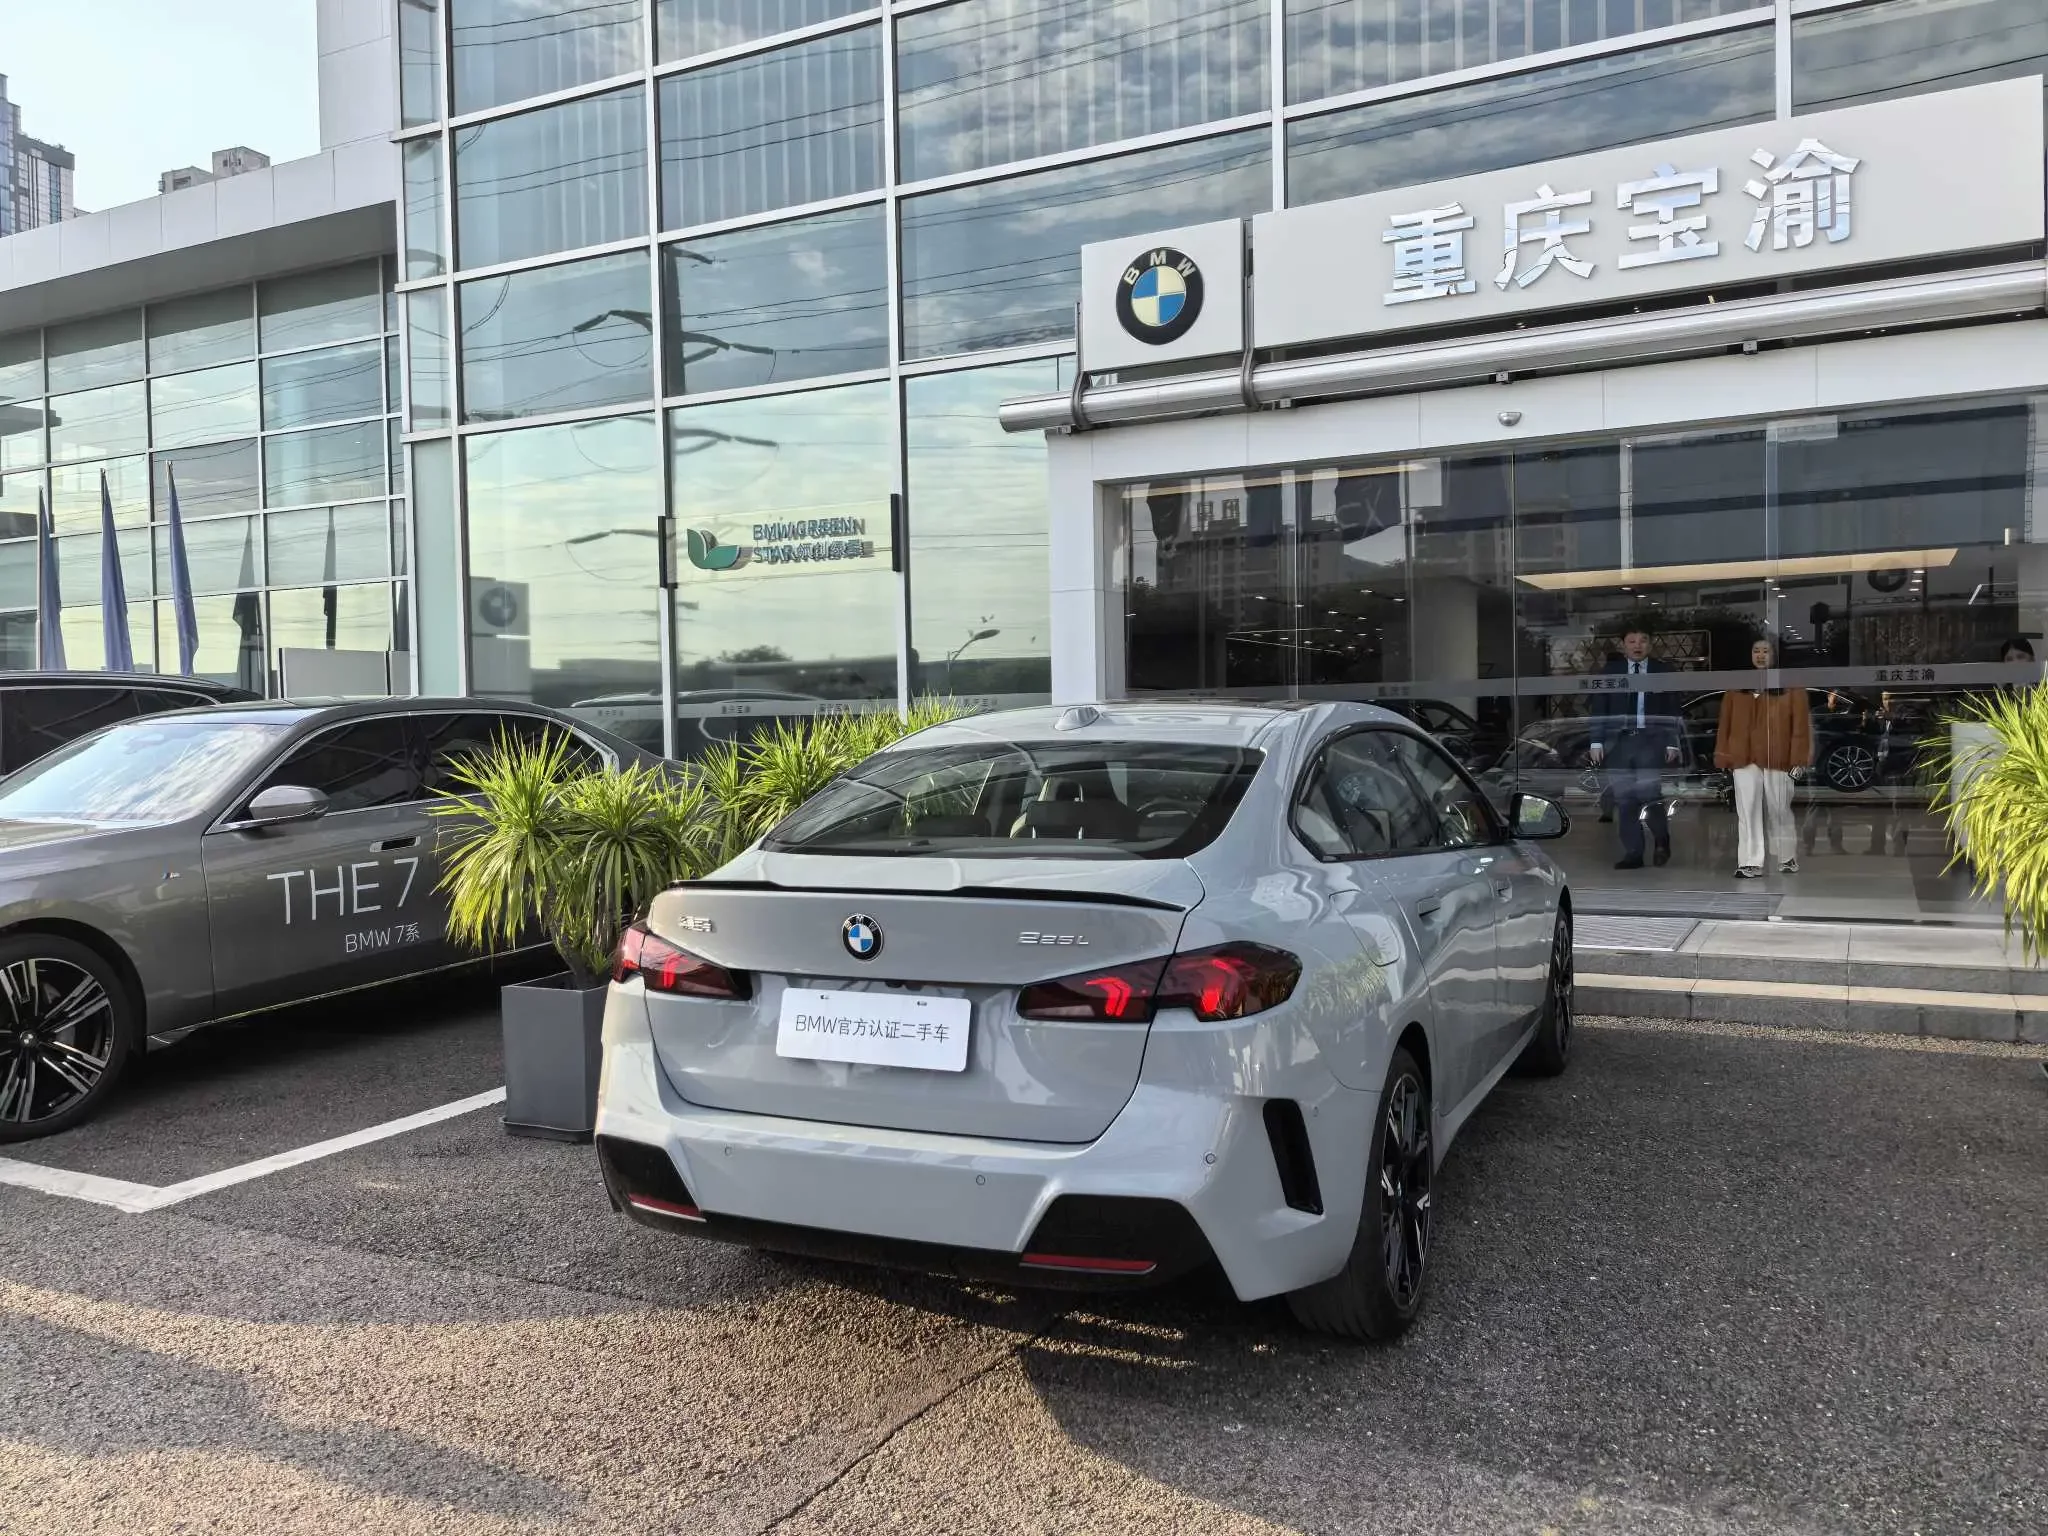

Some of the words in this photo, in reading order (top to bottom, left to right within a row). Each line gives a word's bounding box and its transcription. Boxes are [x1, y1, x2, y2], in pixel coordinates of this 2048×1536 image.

[1382, 138, 1862, 306] 重庆宝渝
[1123, 250, 1196, 286] BMW
[753, 522, 793, 541] BMW
[797, 516, 862, 537] GREEN
[267, 861, 382, 925] THE
[394, 856, 419, 908] 7
[345, 927, 391, 953] BMW
[394, 922, 421, 944] 7系
[1018, 931, 1089, 945] 225L
